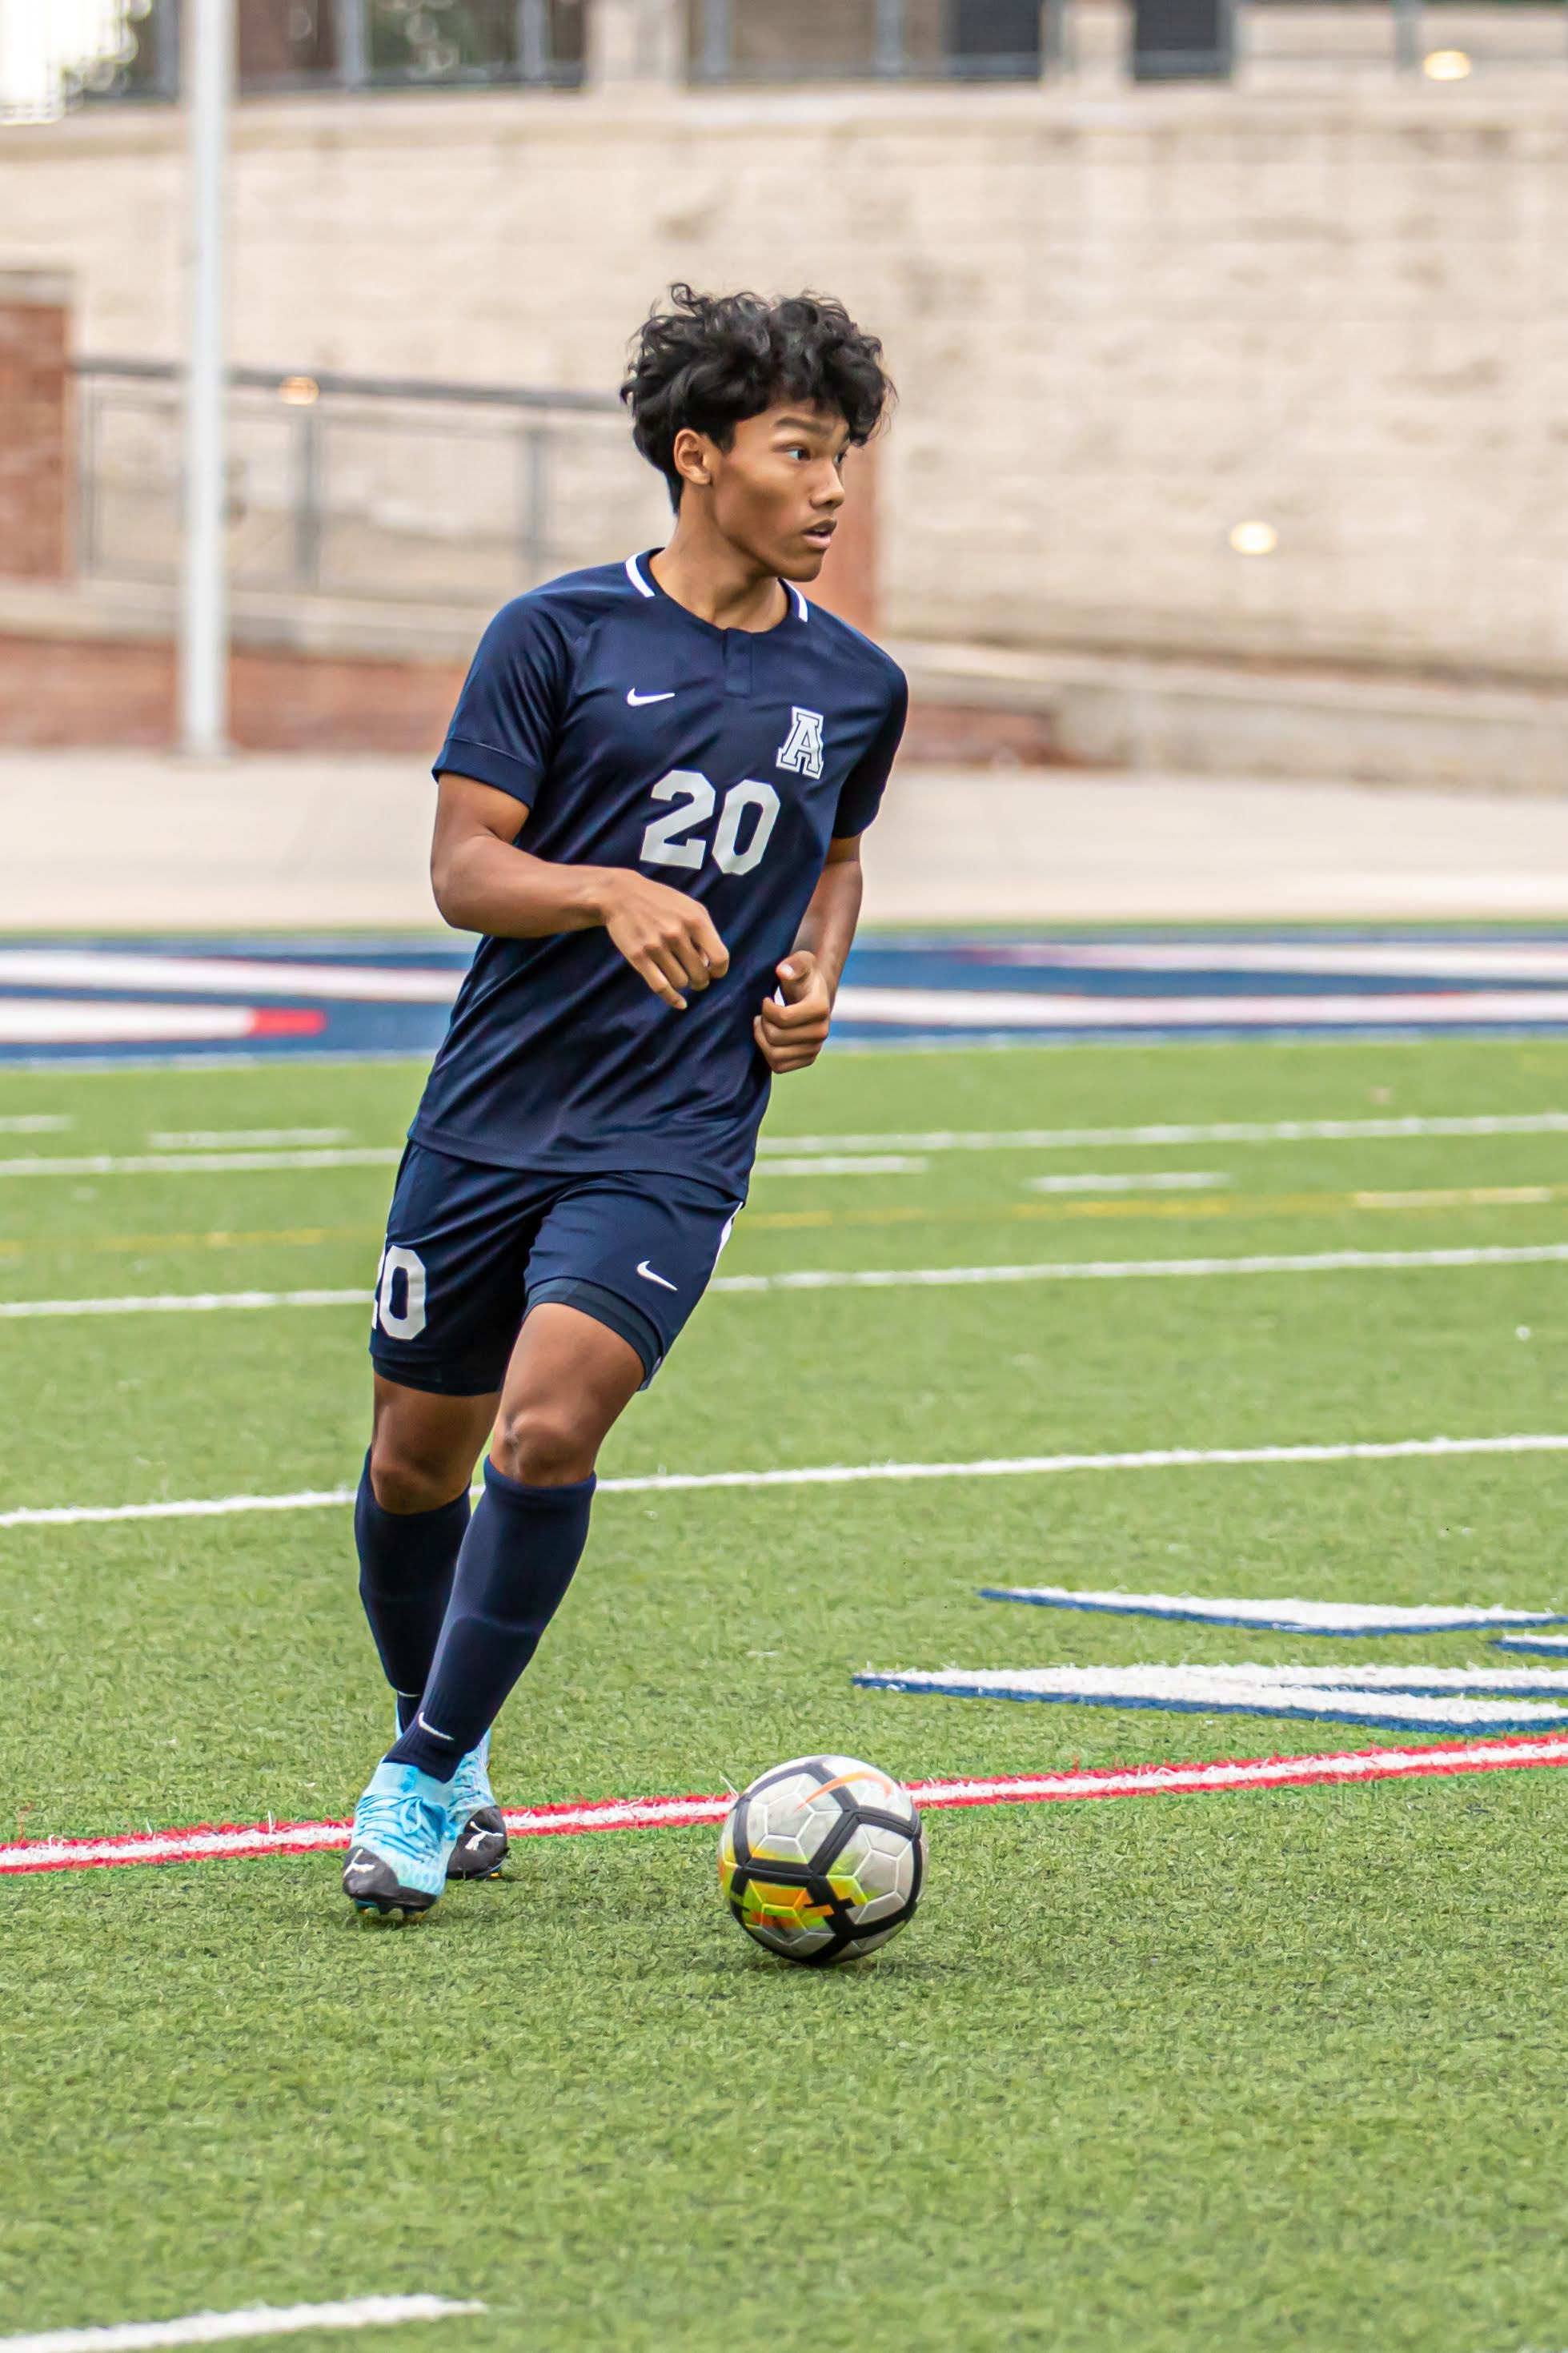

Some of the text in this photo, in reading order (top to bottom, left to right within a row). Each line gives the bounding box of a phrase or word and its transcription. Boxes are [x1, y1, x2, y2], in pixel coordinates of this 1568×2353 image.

[776, 705, 824, 780] A
[640, 769, 780, 876] 20
[372, 1239, 427, 1340] 0
